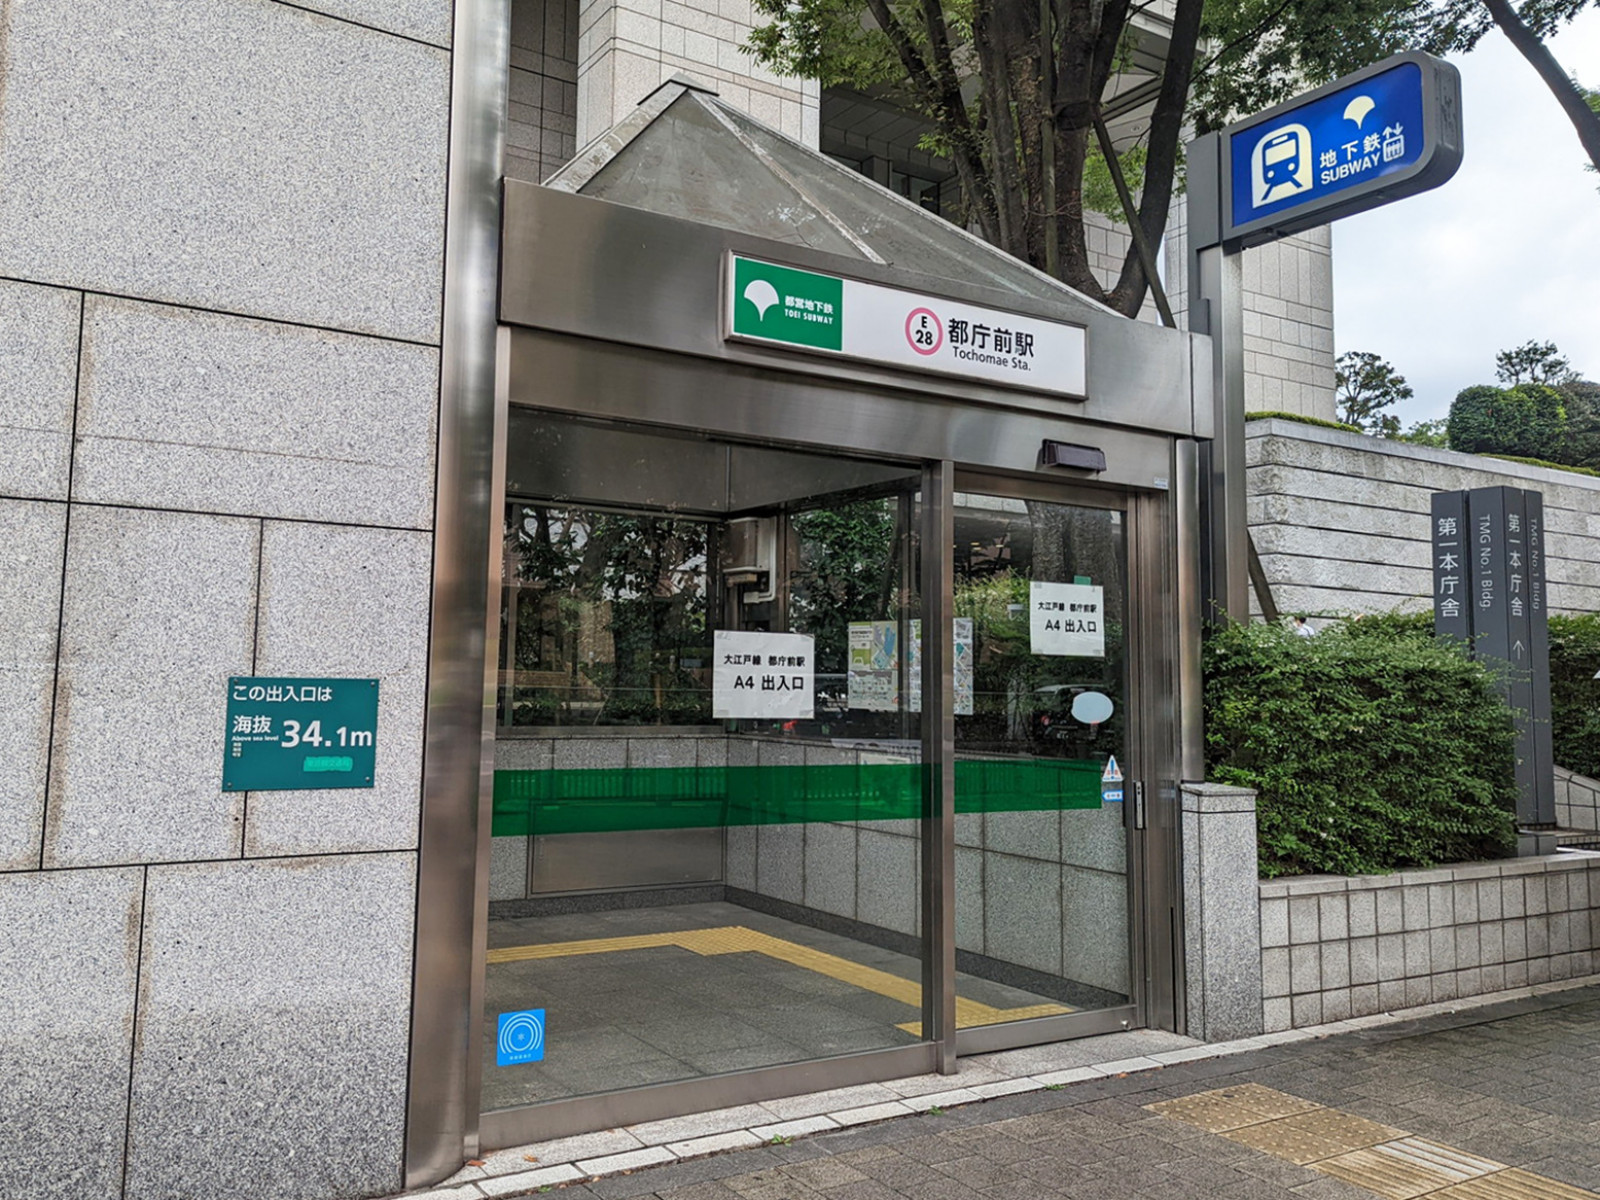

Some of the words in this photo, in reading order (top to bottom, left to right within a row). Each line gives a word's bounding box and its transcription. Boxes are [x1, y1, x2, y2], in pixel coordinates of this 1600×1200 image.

[1319, 132, 1381, 169] 地下鉄
[1320, 152, 1381, 185] SUBWAY
[784, 295, 834, 315] 都営地下鉄
[784, 308, 801, 319] TOEI
[803, 312, 834, 325] SUBWAY
[921, 315, 928, 329] E
[915, 329, 933, 346] 28
[948, 317, 1034, 358] 都庁前駅
[952, 346, 1009, 367] Tochomae
[1011, 357, 1031, 371] Sta.
[1479, 513, 1491, 544] TMG
[1530, 518, 1539, 546] TMG
[1437, 517, 1460, 617] 第一本庁舎
[1508, 513, 1523, 617] 第一本庁舎
[1479, 579, 1494, 612] Bldg.
[1532, 582, 1541, 613] Bldg.
[1044, 619, 1061, 631] A4
[1064, 618, 1097, 633] 出入口
[723, 654, 762, 666] 大江戸線
[768, 655, 806, 667] 都庁前駅
[233, 685, 333, 702] この出入口は
[734, 675, 755, 689] A4
[761, 674, 804, 691] 出入口
[232, 715, 272, 734] 海抜
[281, 720, 372, 748] 34.1m
